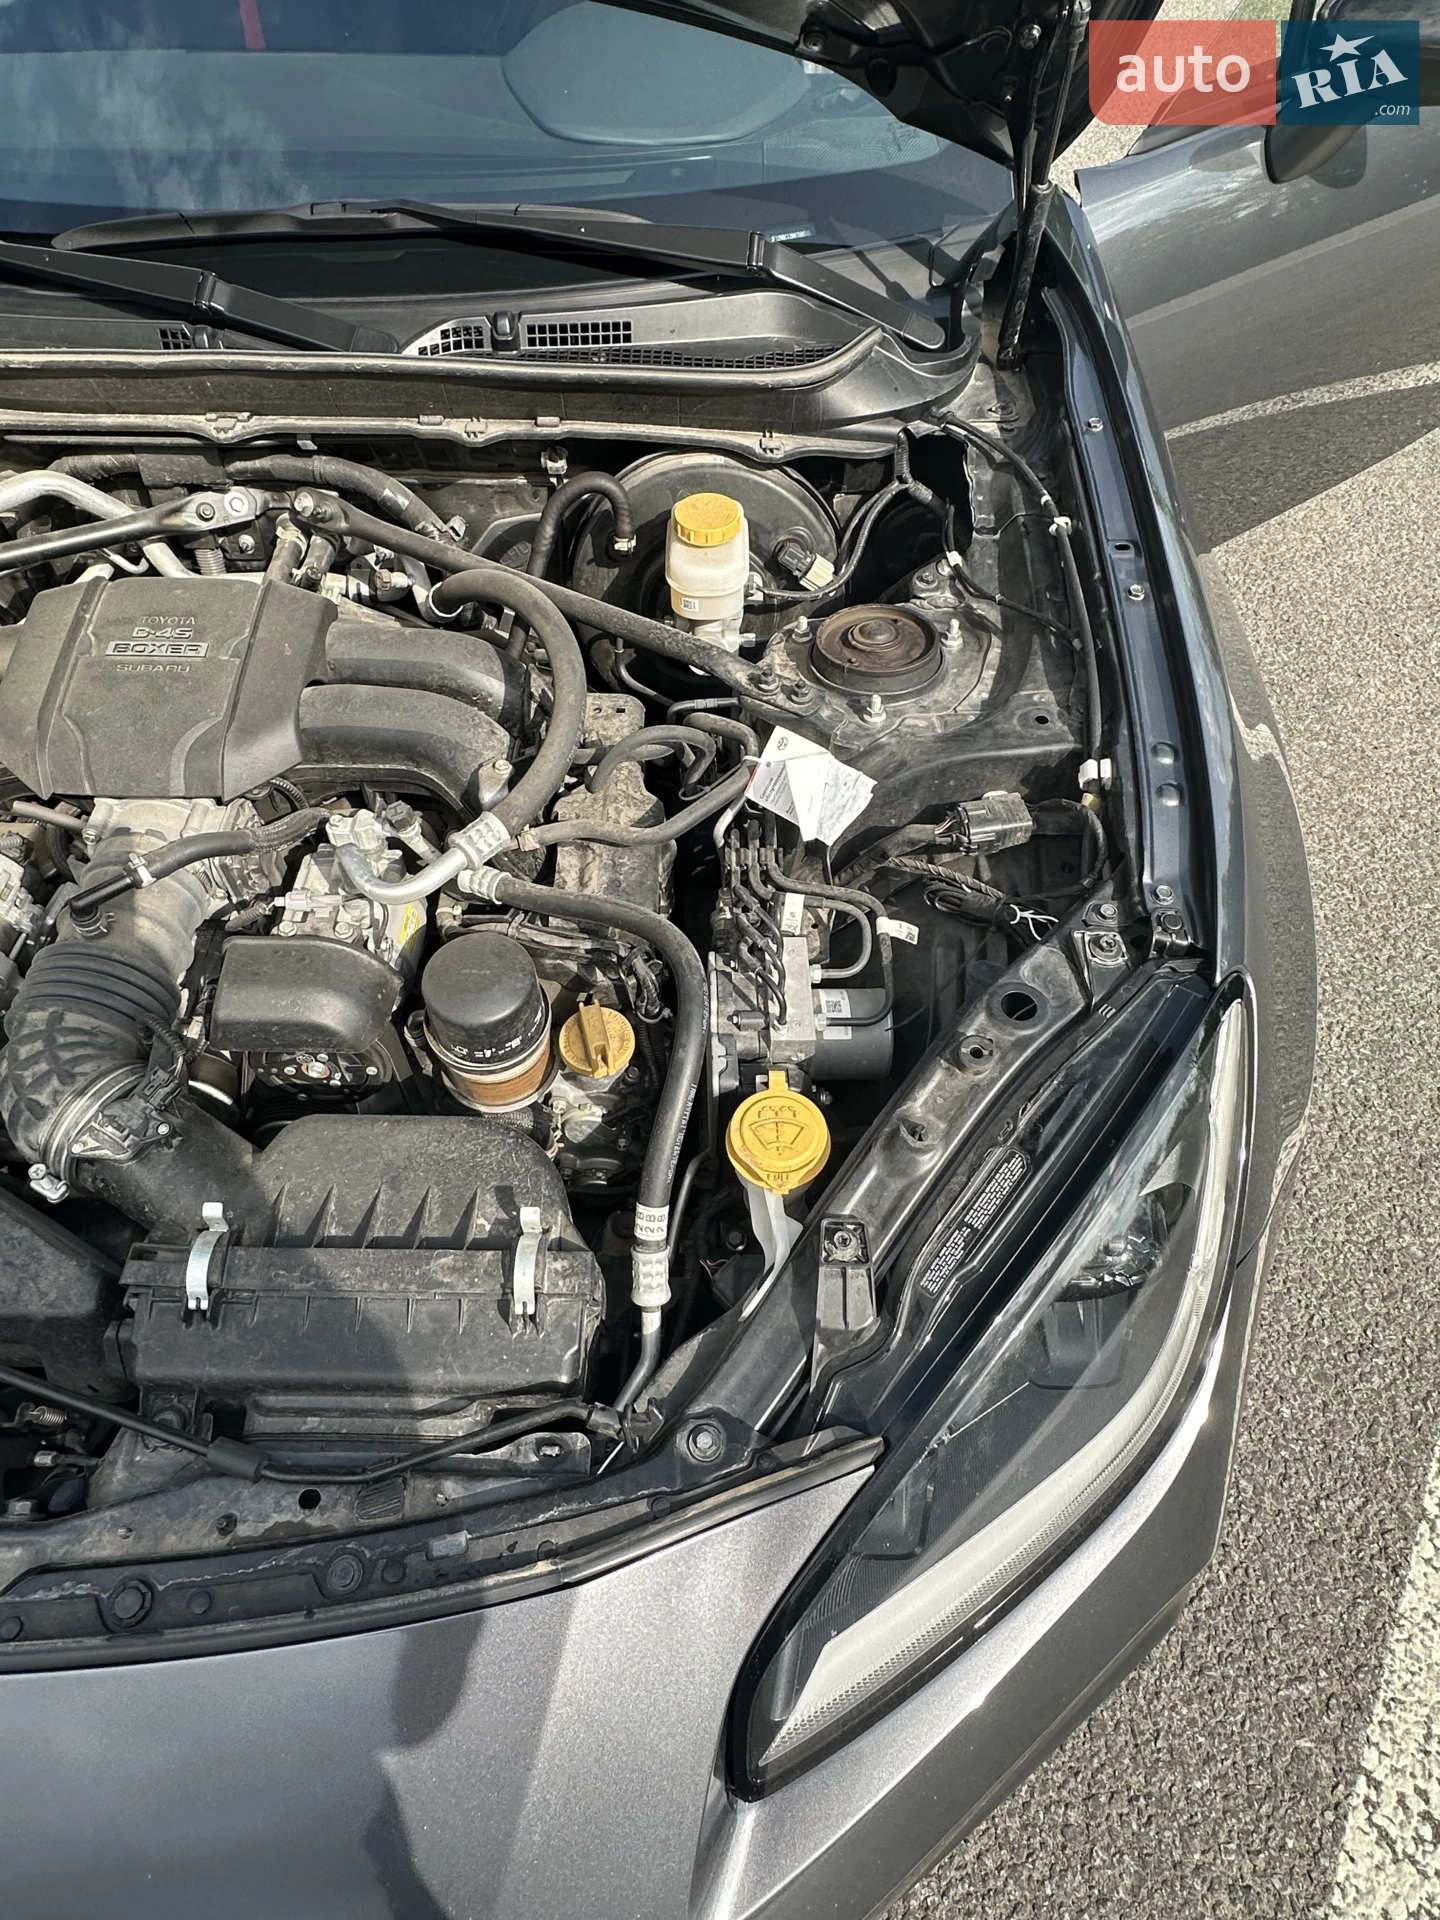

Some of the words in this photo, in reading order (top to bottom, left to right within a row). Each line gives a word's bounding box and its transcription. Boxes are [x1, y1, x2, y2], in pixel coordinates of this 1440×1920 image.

[140, 616, 197, 625] TOYOTA
[112, 642, 204, 655] BOXER
[116, 663, 191, 673] SUBARU
